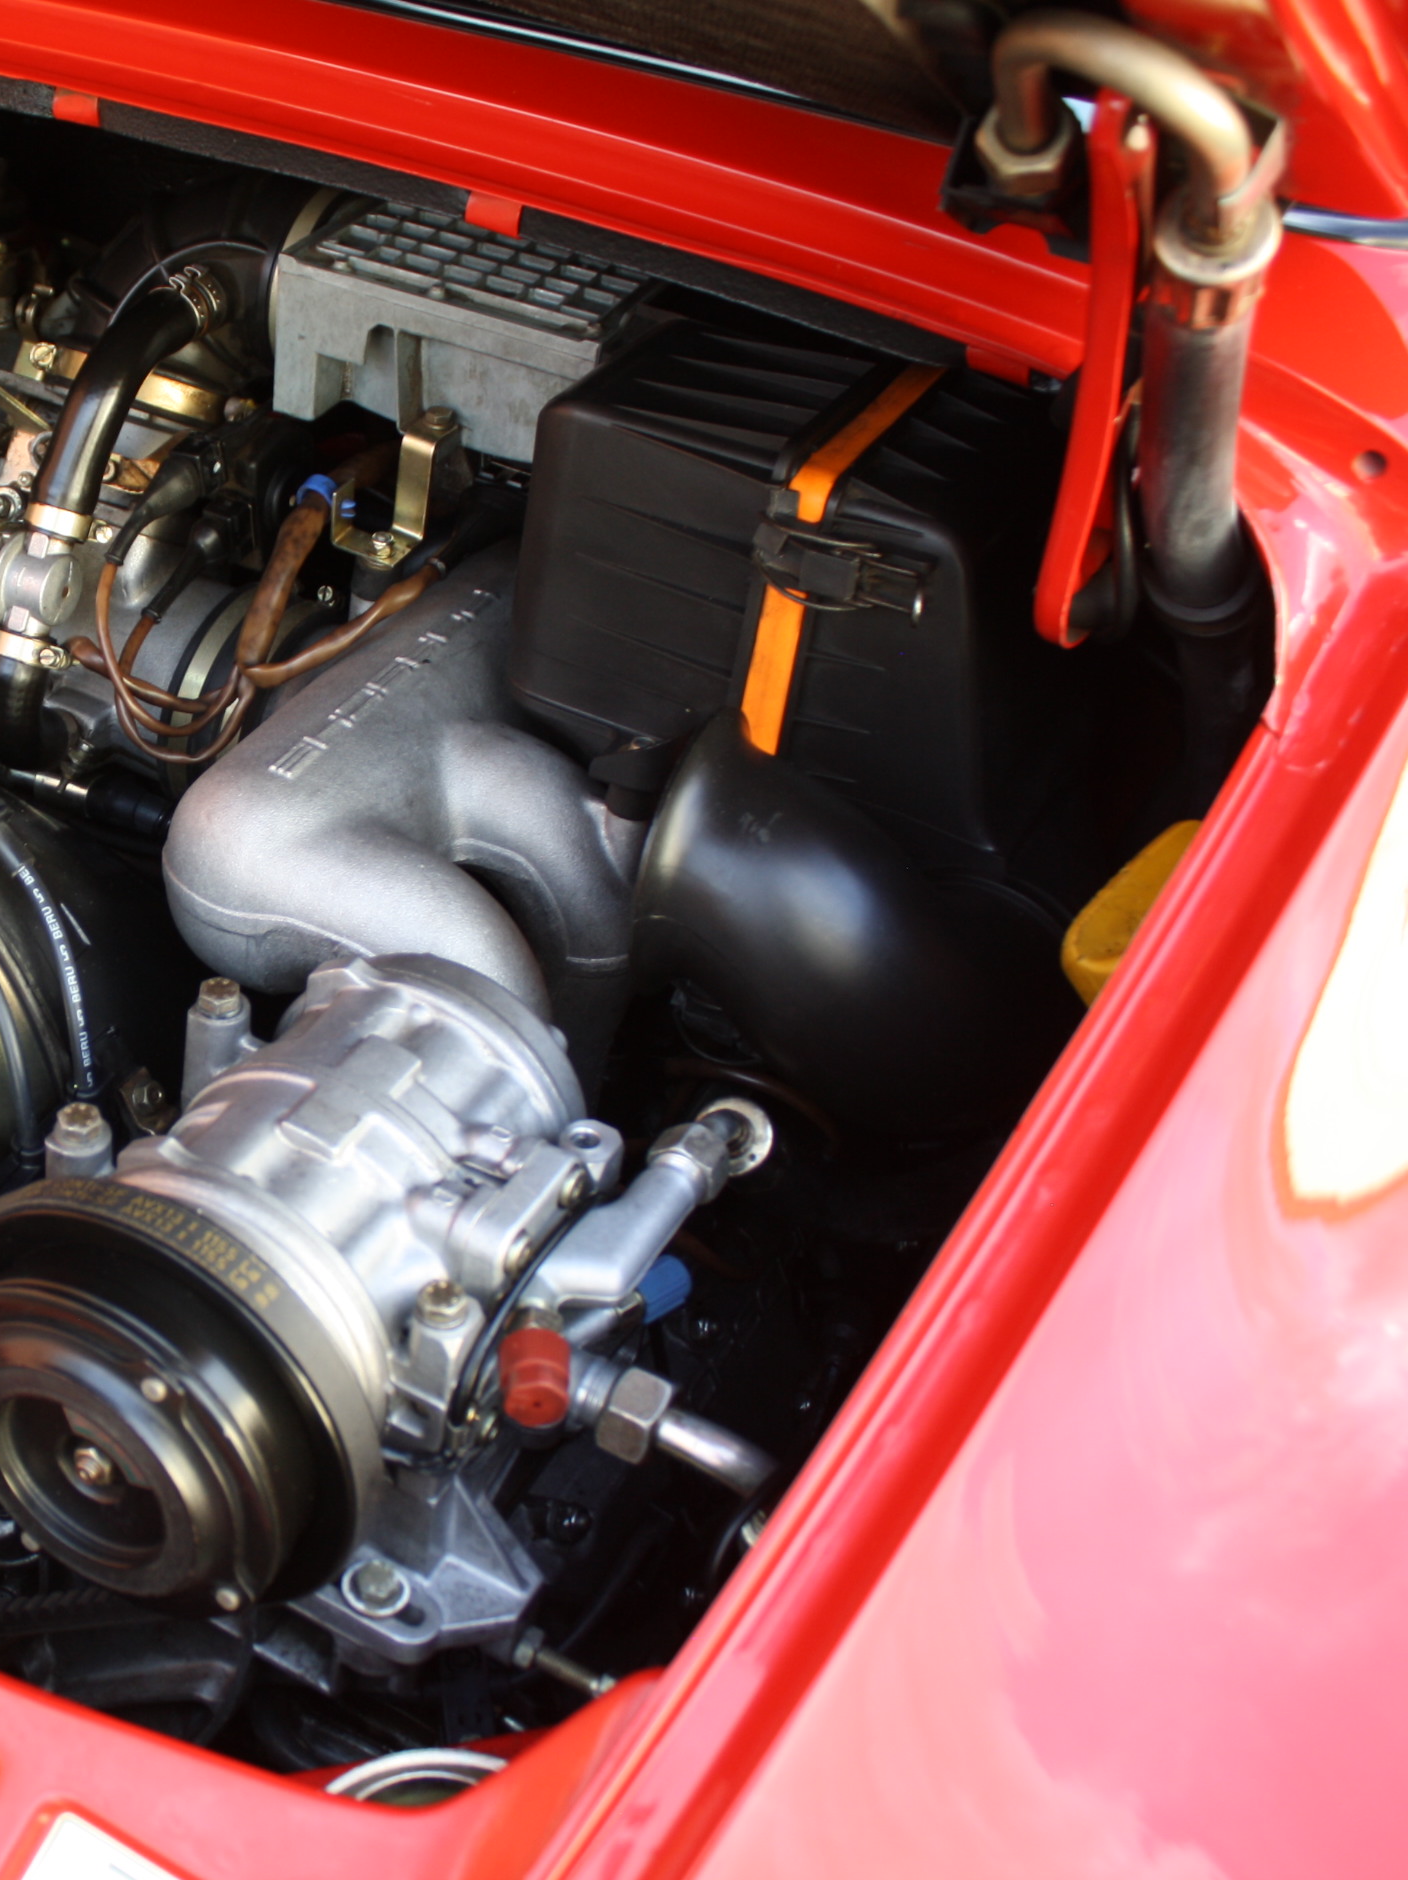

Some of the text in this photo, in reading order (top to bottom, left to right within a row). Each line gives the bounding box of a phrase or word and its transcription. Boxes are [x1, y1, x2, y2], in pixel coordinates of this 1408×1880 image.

[41, 906, 64, 940] BERU
[64, 966, 82, 1003] BERU
[78, 1032, 91, 1068] BERU
